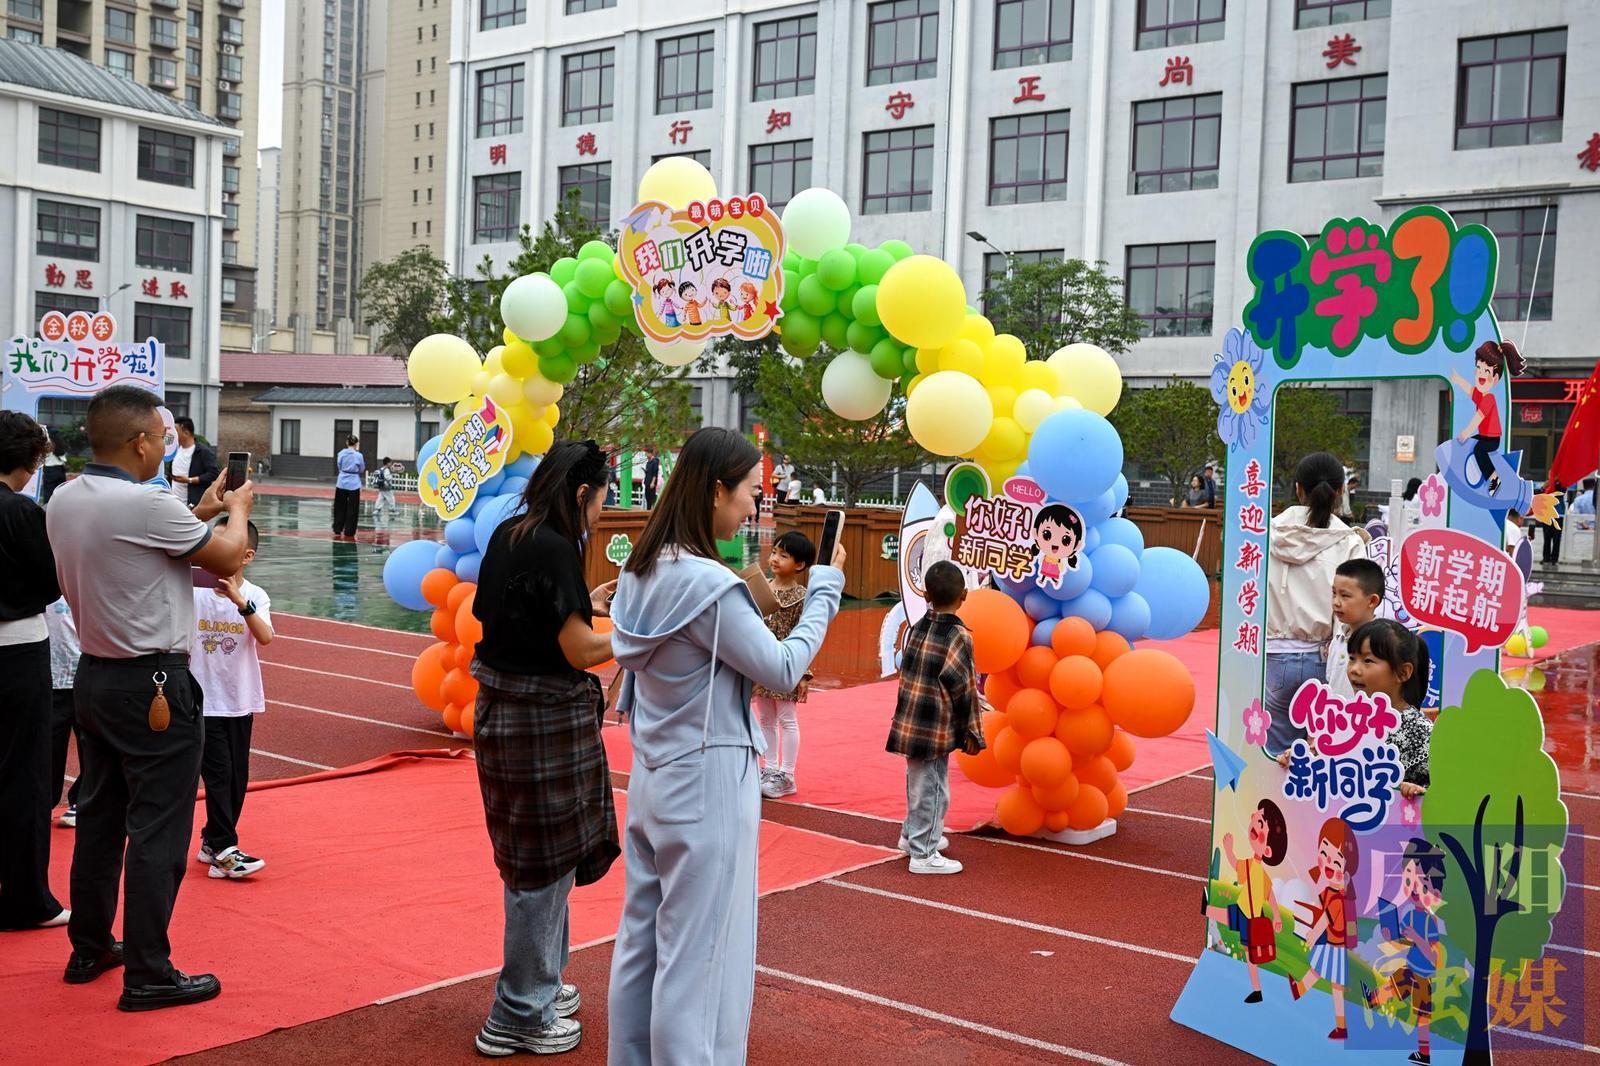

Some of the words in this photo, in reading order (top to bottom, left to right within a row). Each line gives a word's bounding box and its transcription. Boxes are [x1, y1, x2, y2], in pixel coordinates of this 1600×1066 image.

[690, 196, 762, 221] 最萌宝贝
[45, 263, 94, 290] 勤思
[634, 226, 772, 280] 我们开学啦
[1247, 214, 1491, 362] 开学了!
[45, 316, 112, 339] 金秋季
[9, 338, 156, 381] 我们开学啦!
[436, 413, 486, 479] 新学期
[441, 445, 492, 512] 新希望
[1012, 484, 1041, 498] HELLO
[964, 495, 1033, 541] 你好!
[958, 534, 1034, 580] 新同学
[1235, 458, 1266, 656] 喜迎新学期
[1415, 540, 1507, 598] 新学期
[1410, 576, 1502, 633] 新起航
[1291, 682, 1398, 757] 你好
[1285, 743, 1400, 831] 新同学
